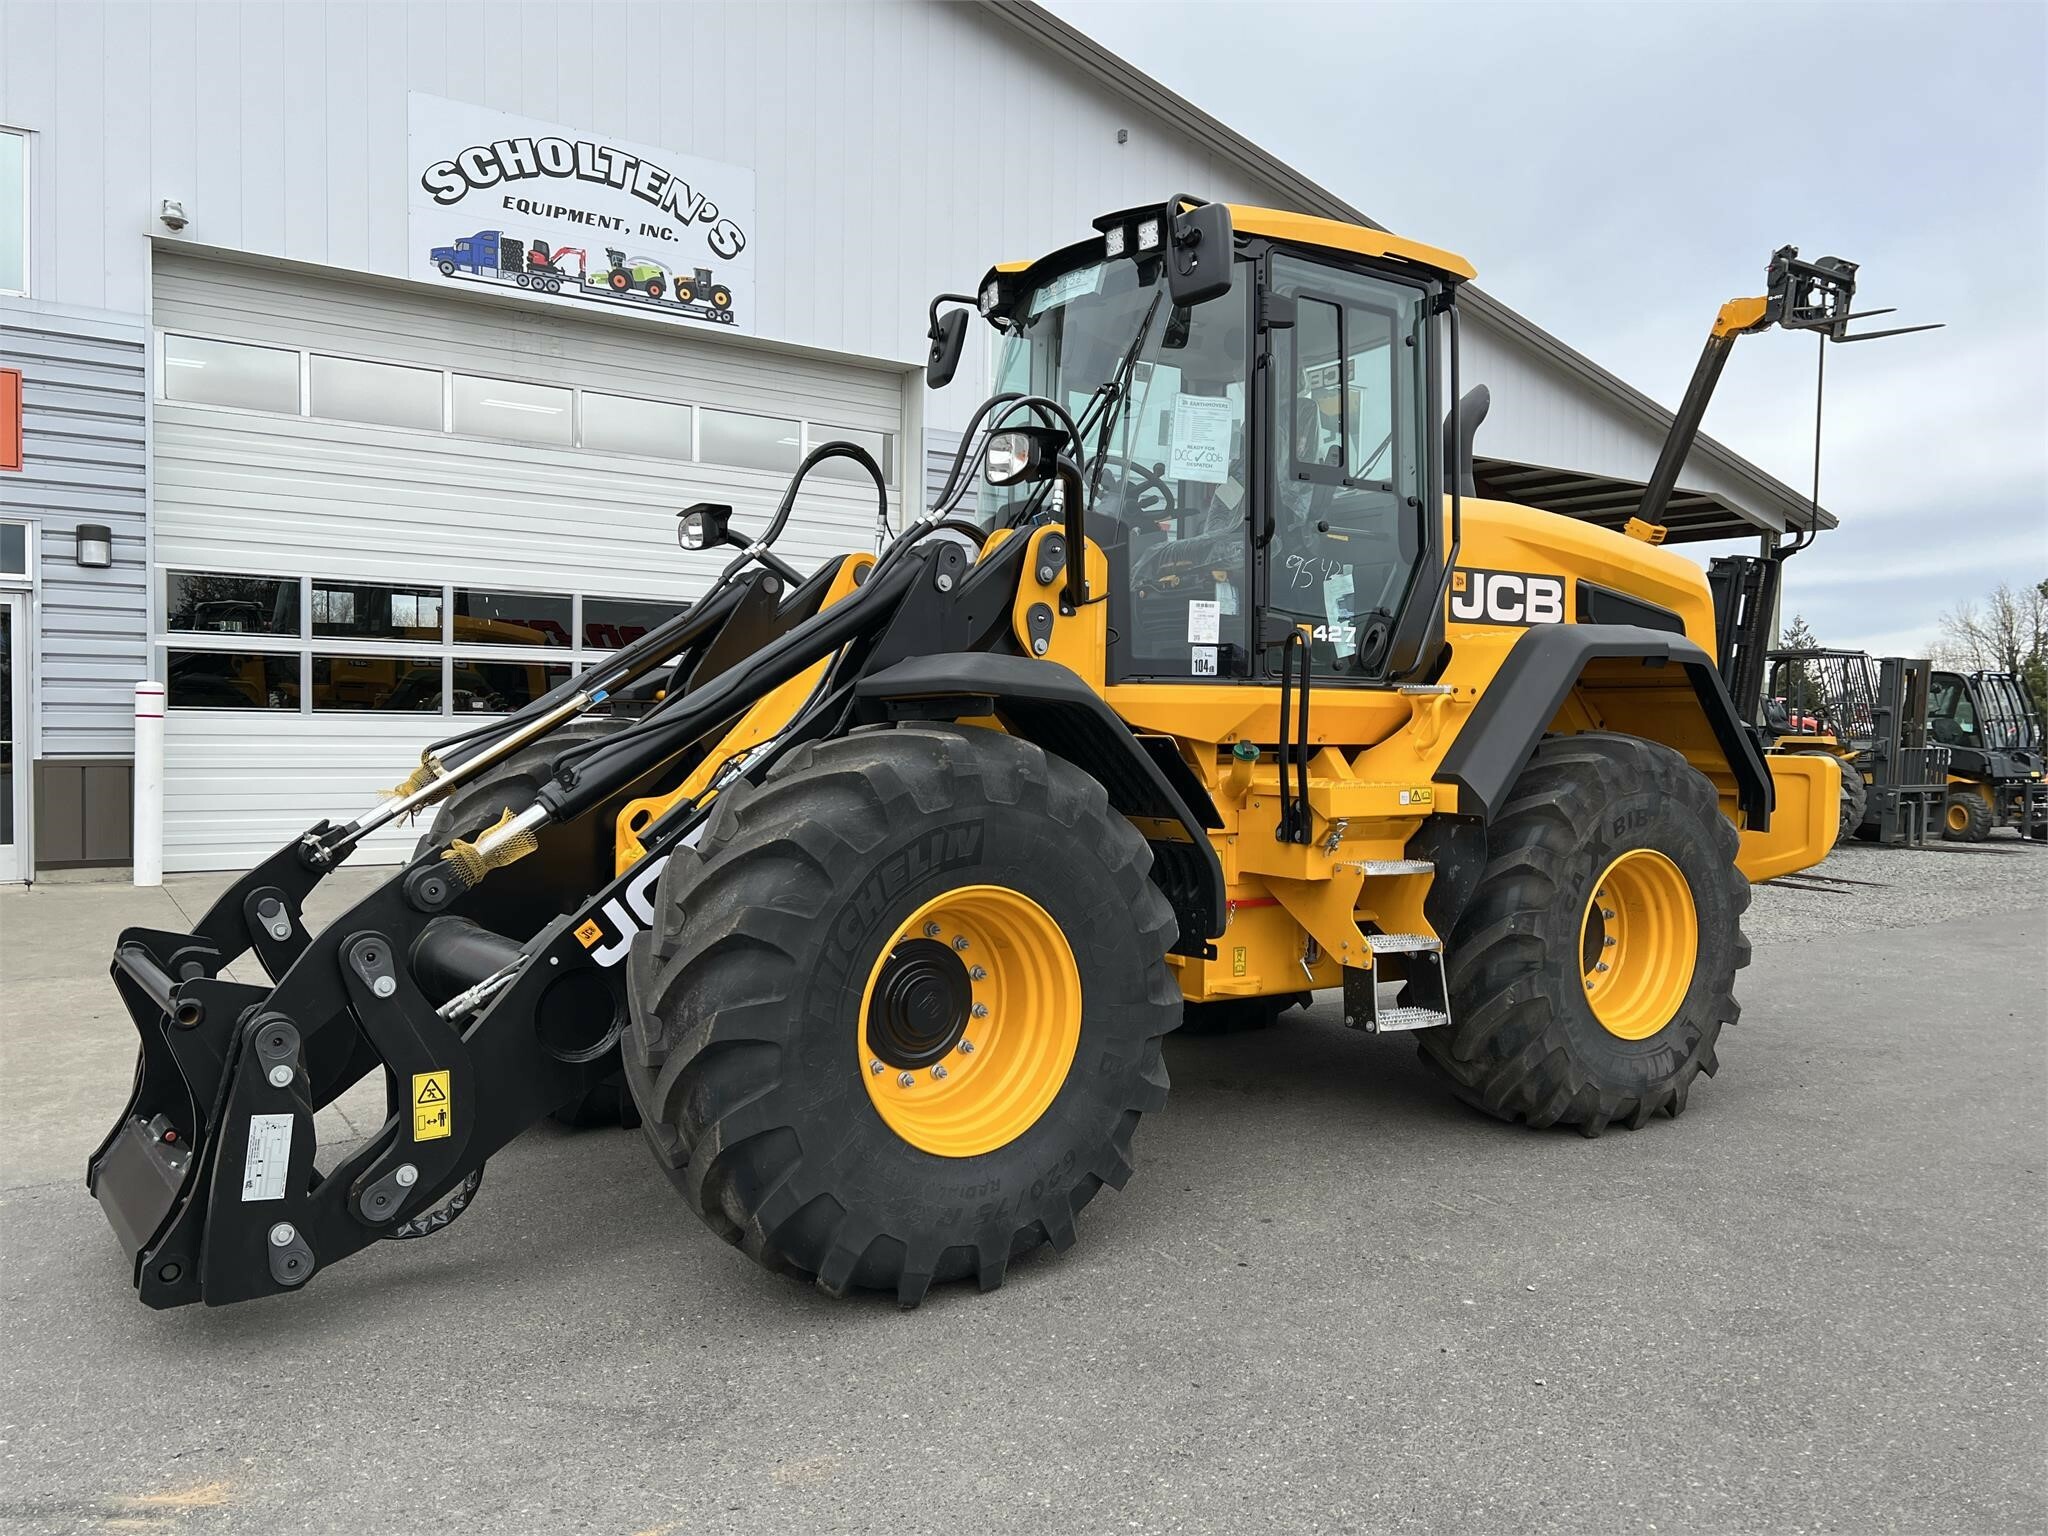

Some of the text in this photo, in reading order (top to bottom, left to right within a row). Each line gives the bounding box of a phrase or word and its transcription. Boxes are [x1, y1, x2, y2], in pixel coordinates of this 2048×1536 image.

[421, 137, 746, 261] SCHOLTEN'S
[639, 223, 679, 243] INC.
[1186, 461, 1214, 469] DESPATCH
[1452, 573, 1563, 624] JCB
[1313, 625, 1356, 643] 427
[1194, 658, 1209, 673] 104
[591, 818, 710, 967] JC
